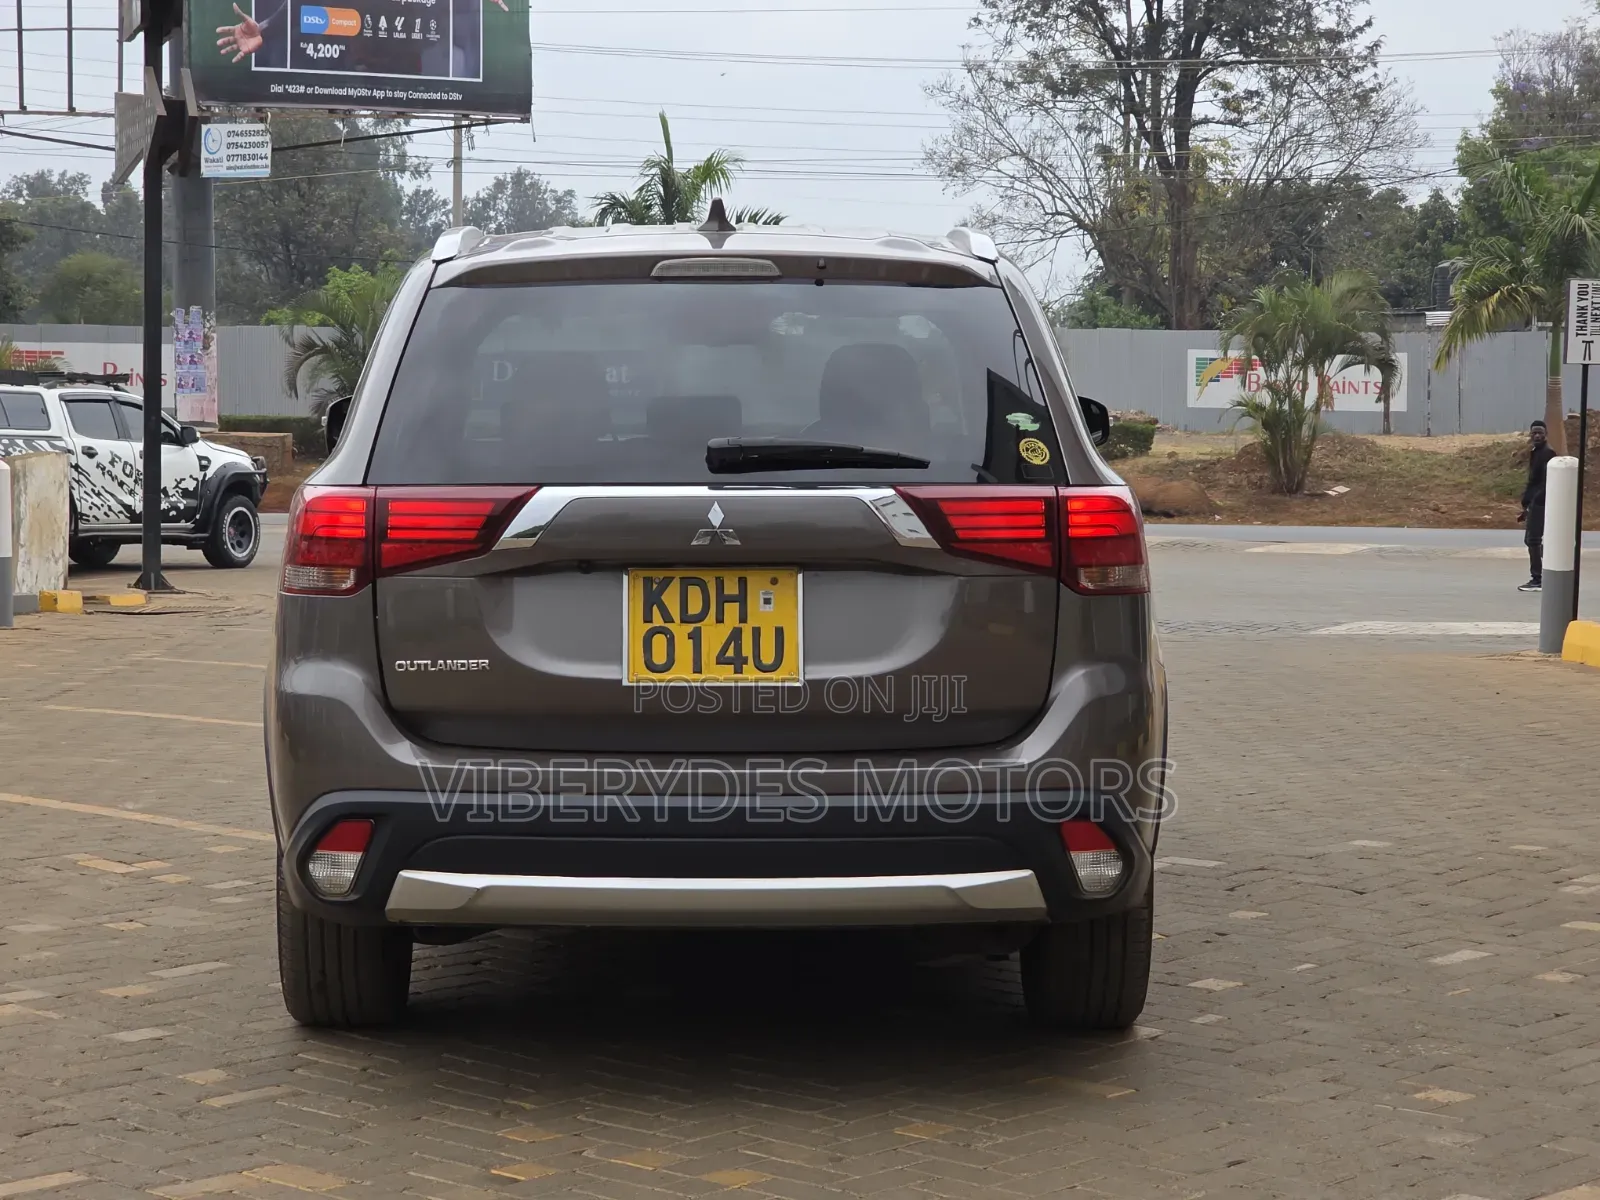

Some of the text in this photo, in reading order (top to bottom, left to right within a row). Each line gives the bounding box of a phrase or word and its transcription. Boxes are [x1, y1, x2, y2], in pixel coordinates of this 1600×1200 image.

[303, 15, 357, 27] DStv Compact
[306, 43, 340, 59] 4,200
[270, 84, 284, 93] Dial
[306, 86, 314, 94] or
[314, 86, 347, 96] Download
[347, 88, 372, 98] MyDStv
[372, 88, 386, 99] App
[386, 89, 393, 98] to
[393, 90, 408, 100] stay
[408, 91, 441, 100] Connected
[441, 92, 448, 100] to
[448, 92, 463, 101] DStv
[226, 141, 269, 150] 0754230057
[204, 156, 223, 164] Wakati
[225, 153, 269, 162] 0771830144
[1575, 283, 1589, 337] THANK YOU
[1590, 300, 1600, 323] NEXT
[643, 576, 748, 624] KDH
[643, 625, 785, 675] 014U
[395, 659, 490, 672] OUTLANDER
